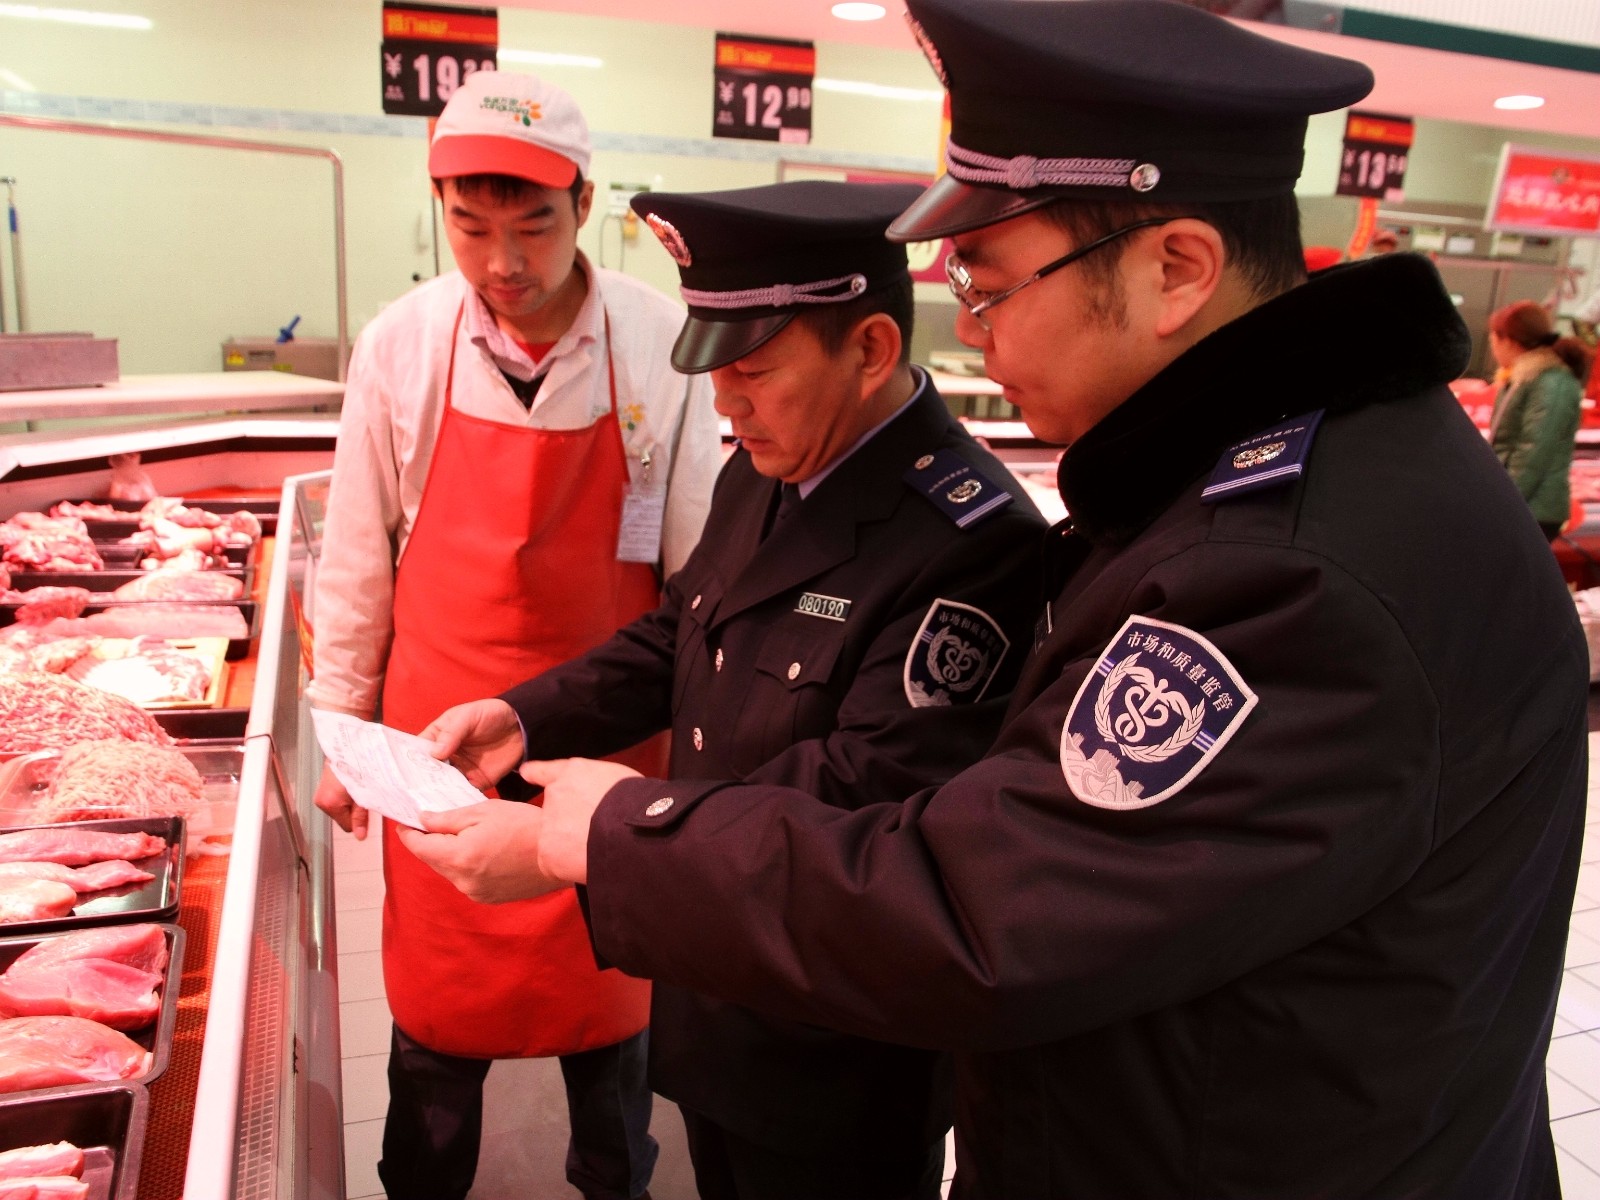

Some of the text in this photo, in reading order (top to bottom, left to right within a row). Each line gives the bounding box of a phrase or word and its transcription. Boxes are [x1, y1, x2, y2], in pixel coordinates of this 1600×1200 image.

[798, 594, 845, 618] 080190
[1127, 631, 1233, 712] 市场和质量监管
